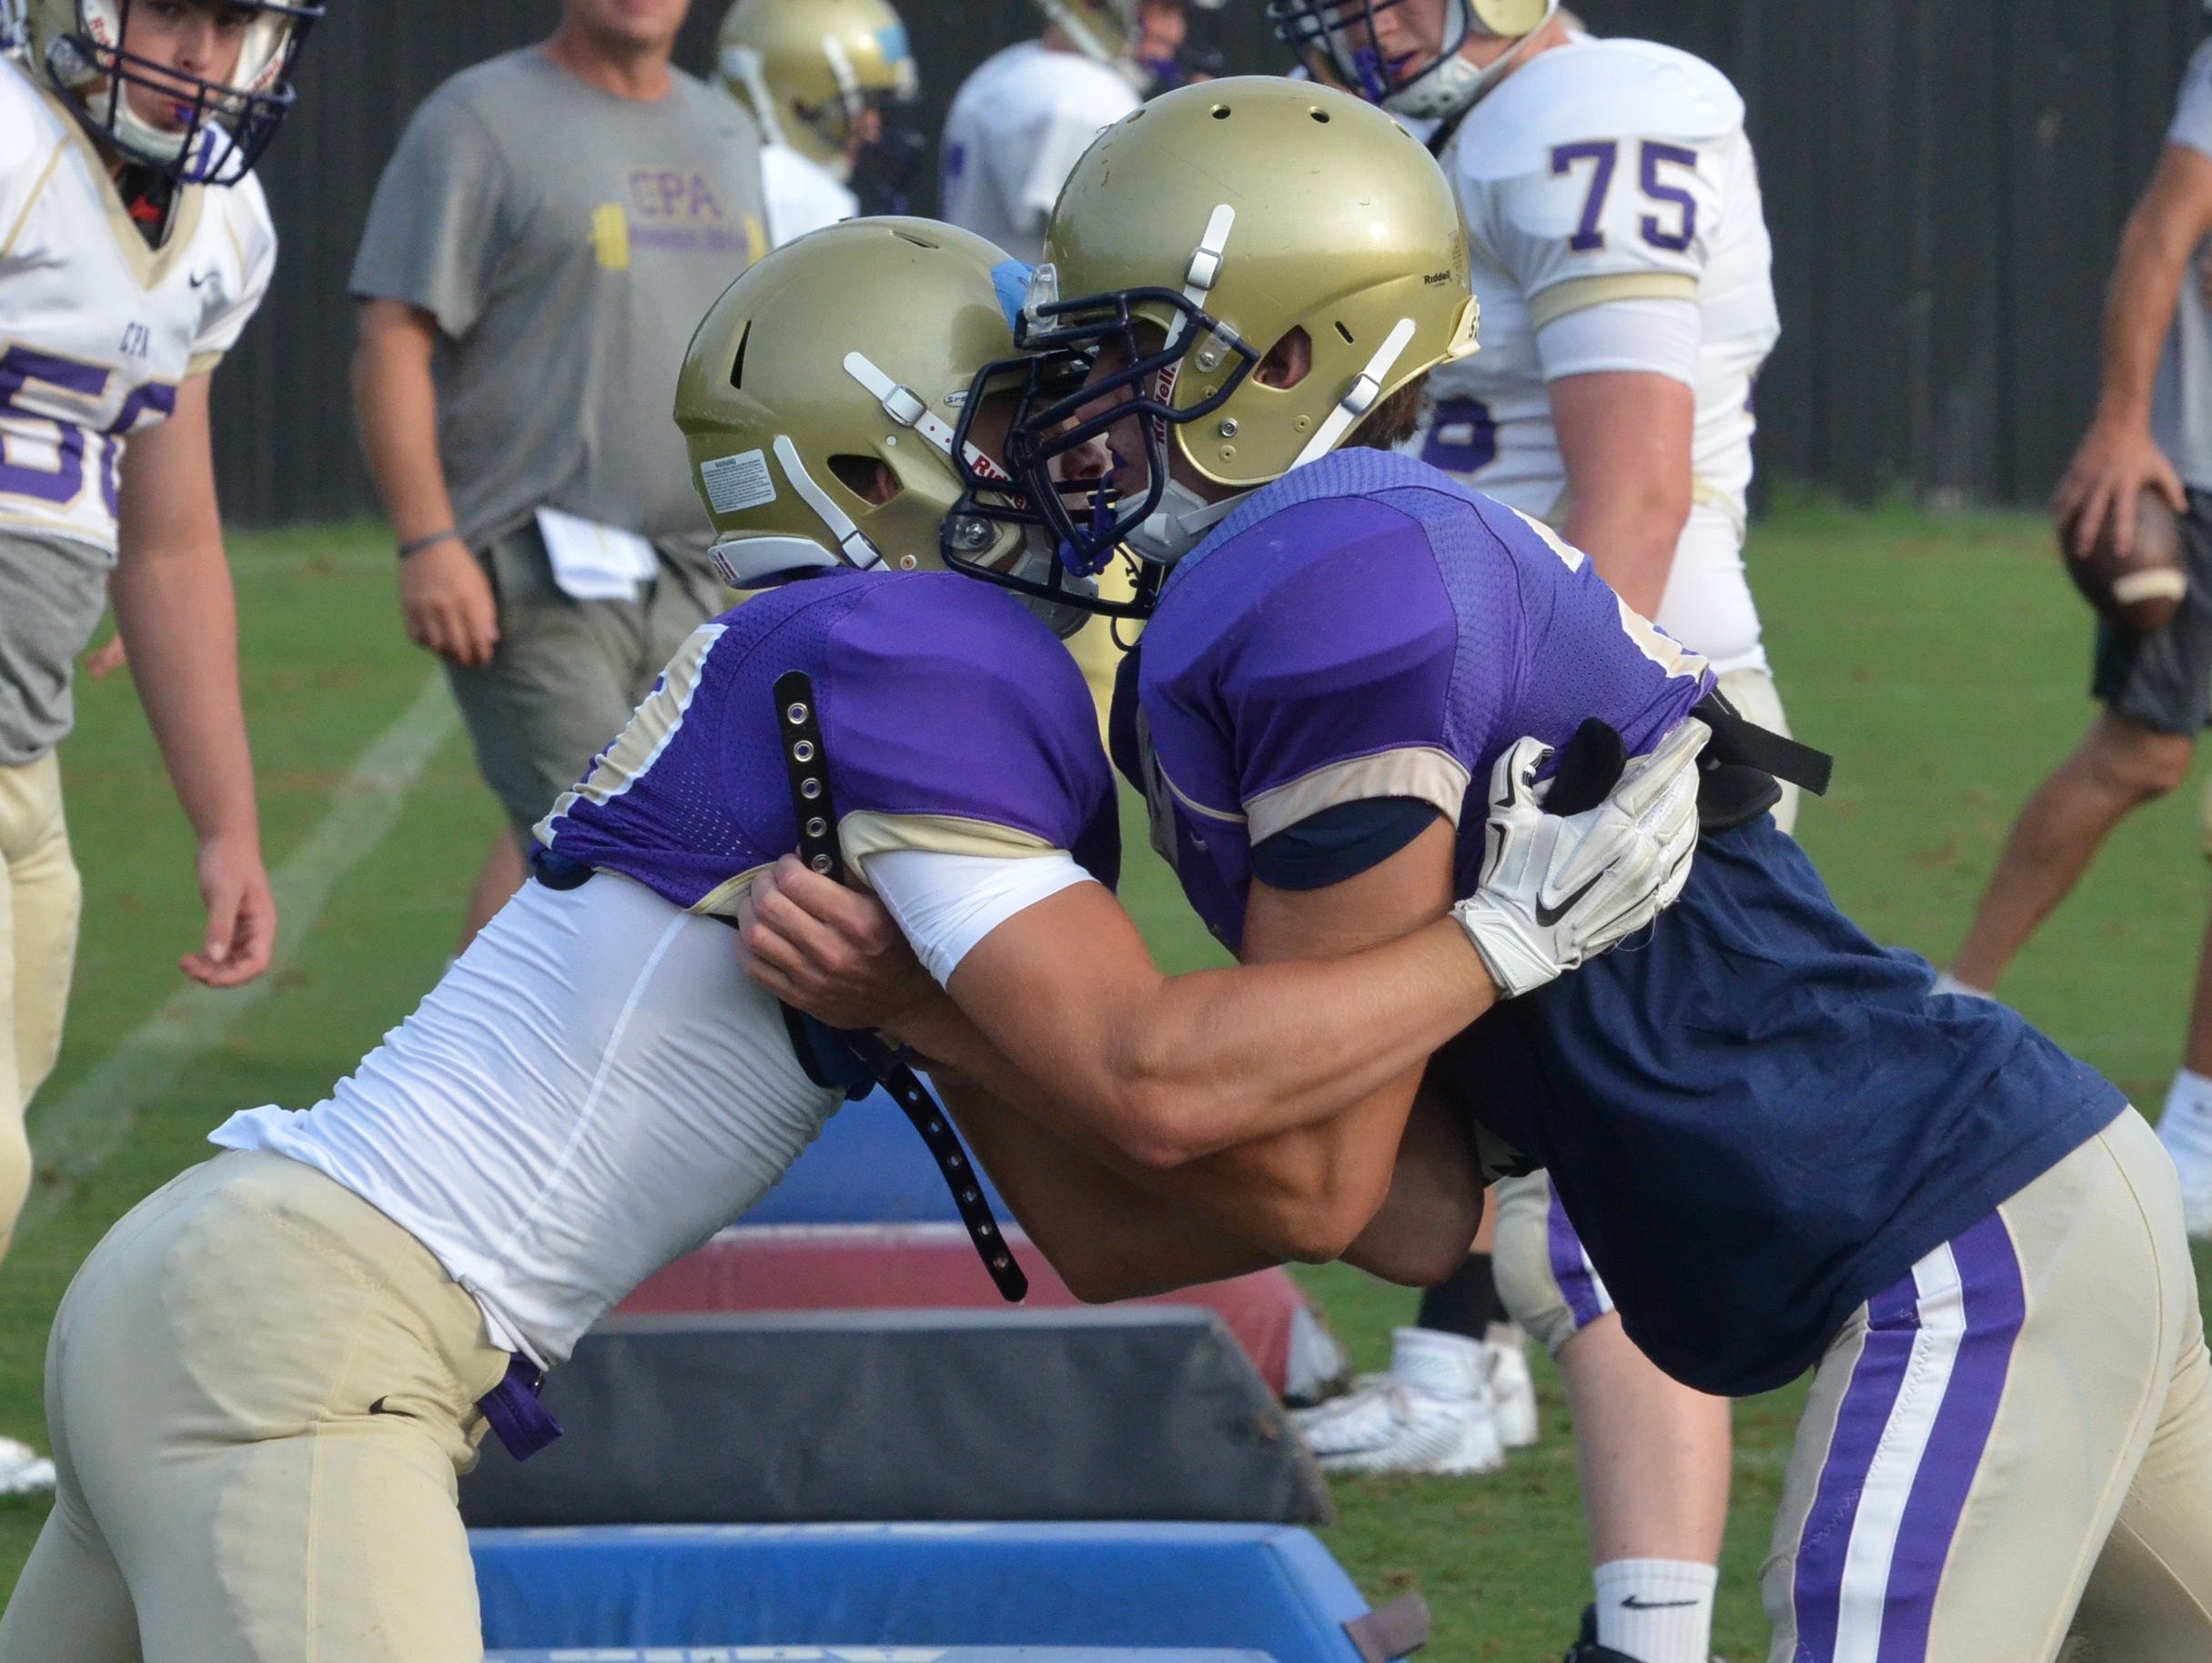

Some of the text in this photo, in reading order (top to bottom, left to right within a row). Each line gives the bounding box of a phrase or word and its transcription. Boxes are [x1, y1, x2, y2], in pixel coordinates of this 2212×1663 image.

[626, 167, 724, 220] CPA
[1550, 138, 1699, 254] 75
[1423, 269, 1451, 285] Riddell
